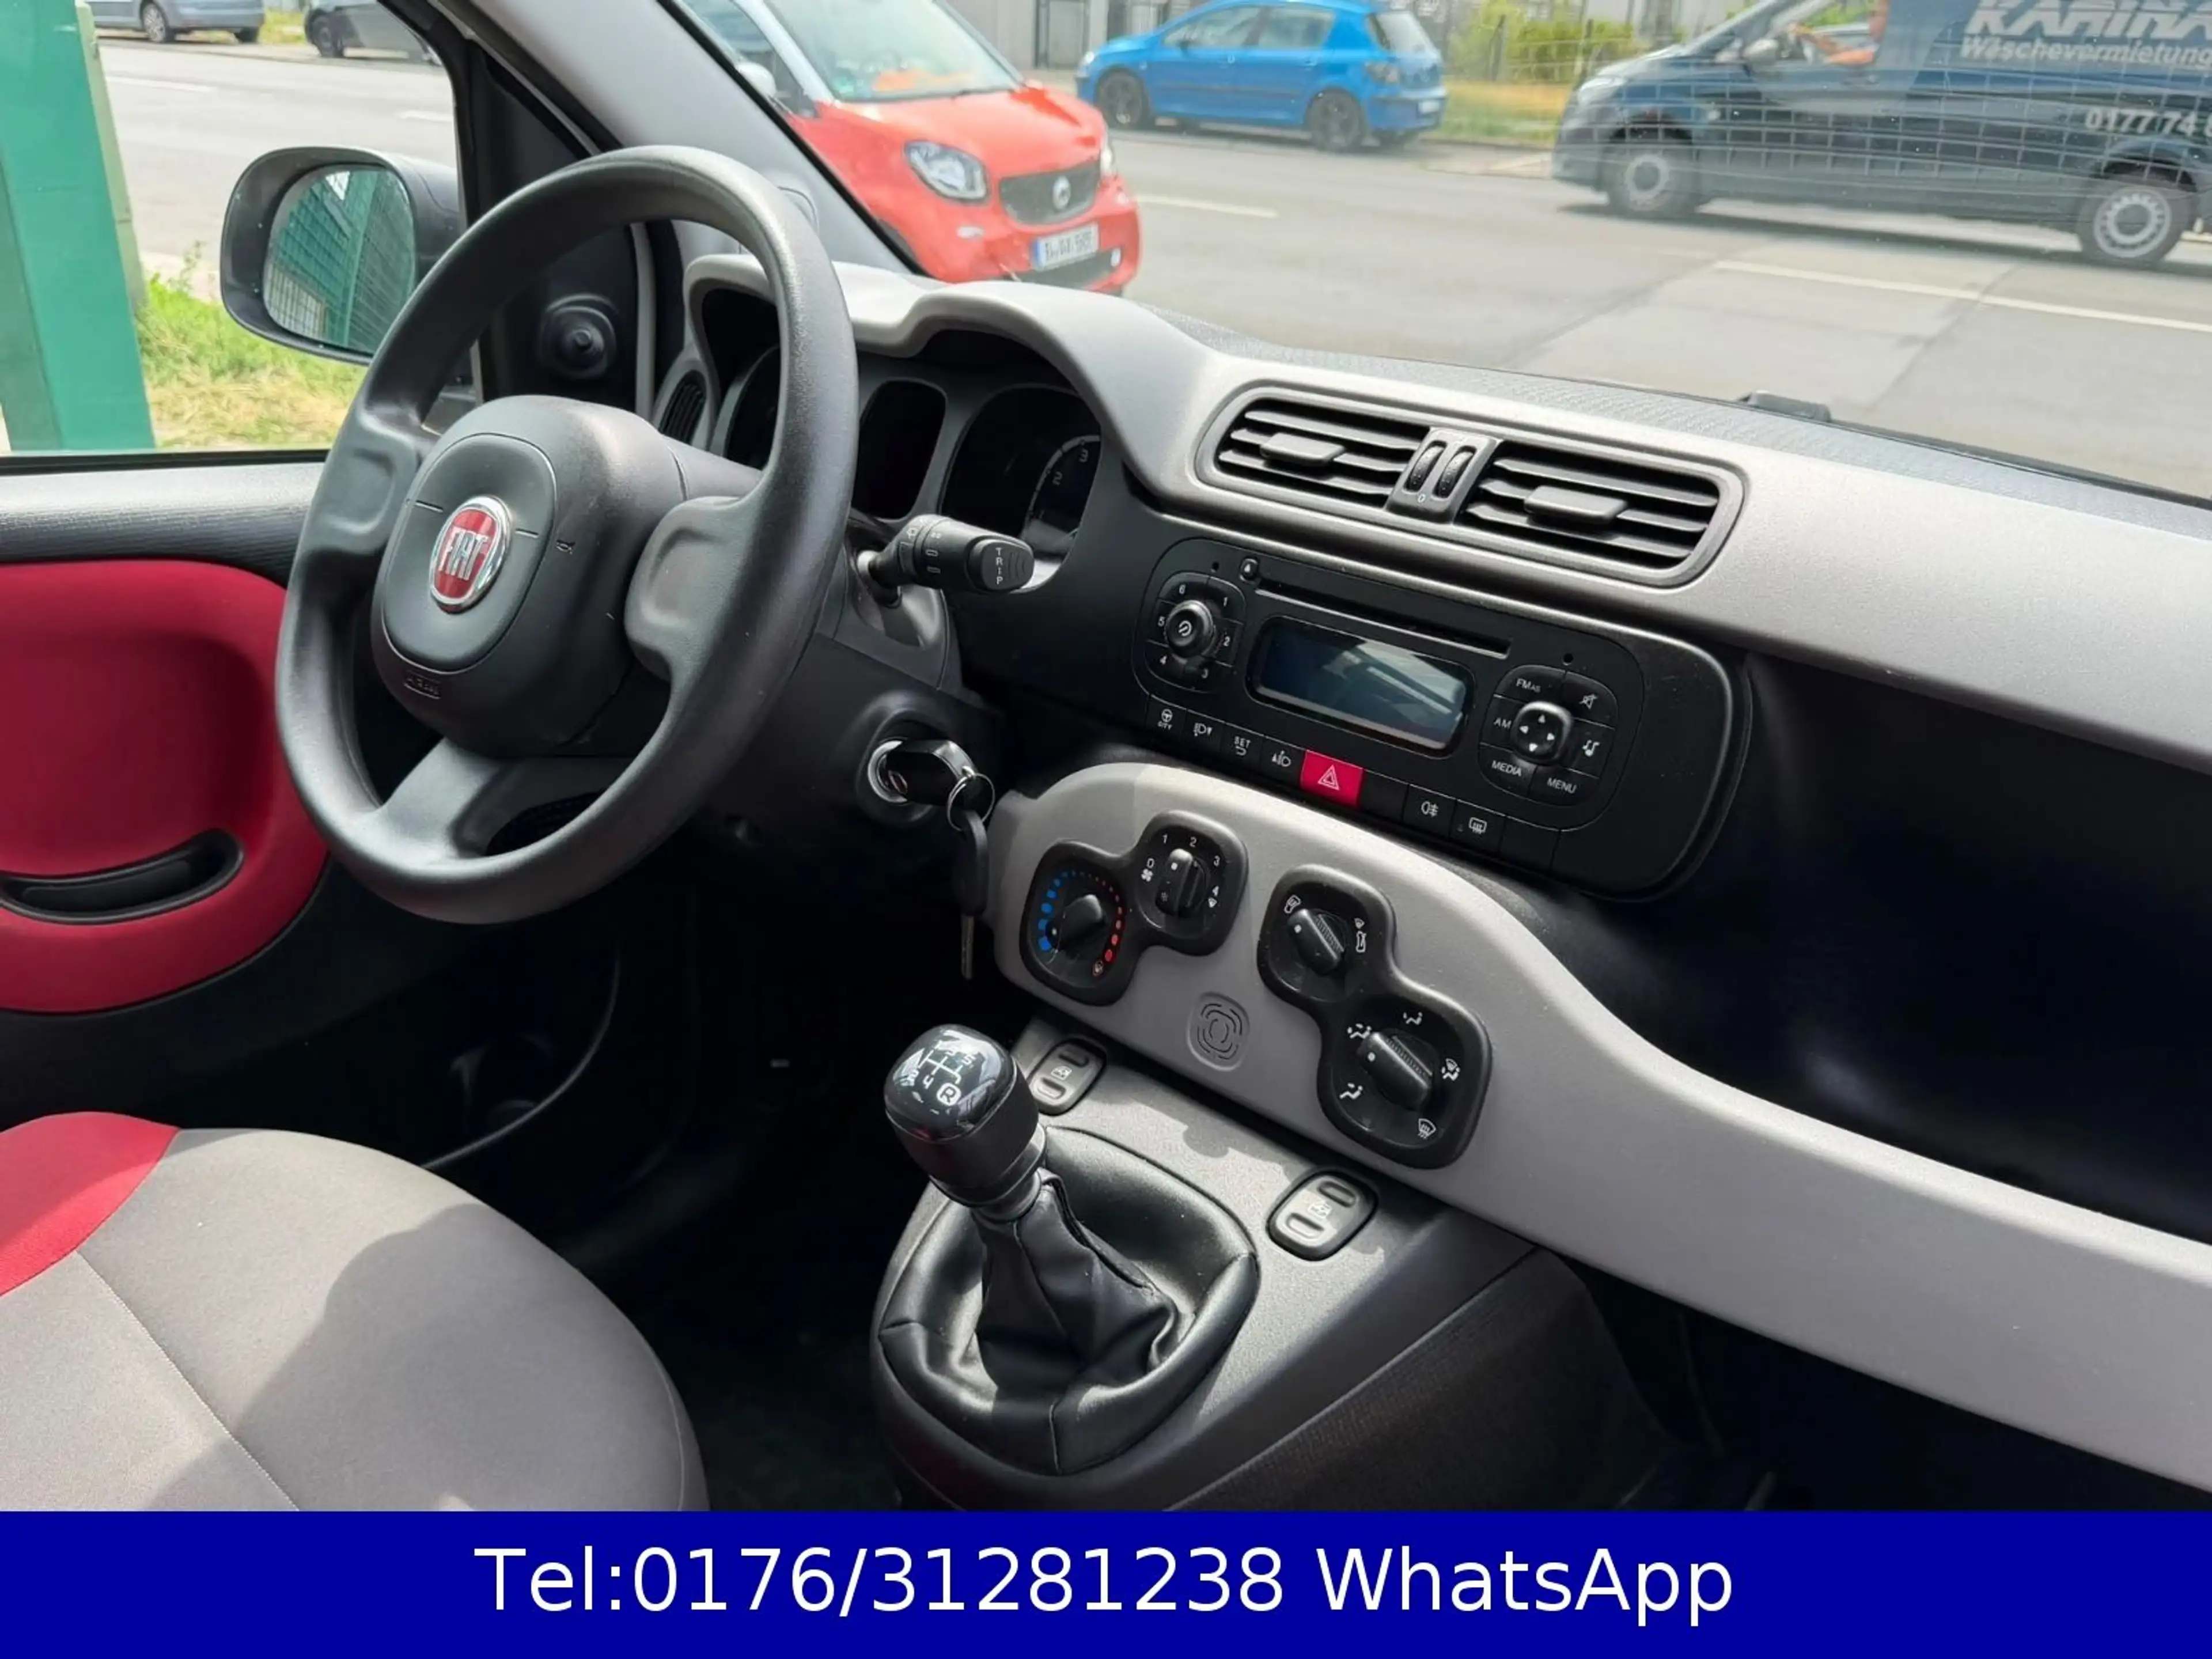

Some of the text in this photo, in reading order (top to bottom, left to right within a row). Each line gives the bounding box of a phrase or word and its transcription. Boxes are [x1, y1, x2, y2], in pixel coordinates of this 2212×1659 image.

[1052, 471, 1063, 486] 2
[438, 525, 490, 581] FIAT
[1179, 584, 1186, 594] 6
[1157, 616, 1165, 627] 5
[1223, 636, 1230, 647] 2
[1160, 655, 1167, 665] 4
[1494, 718, 1512, 729] AM
[1234, 736, 1251, 748] SET
[1491, 760, 1522, 777] MEDIA
[1547, 778, 1577, 794] MENU
[1162, 834, 1168, 844] 1
[1189, 836, 1197, 847] 2
[1213, 855, 1220, 866] 3
[1212, 885, 1219, 896] 4
[923, 1074, 934, 1089] 4
